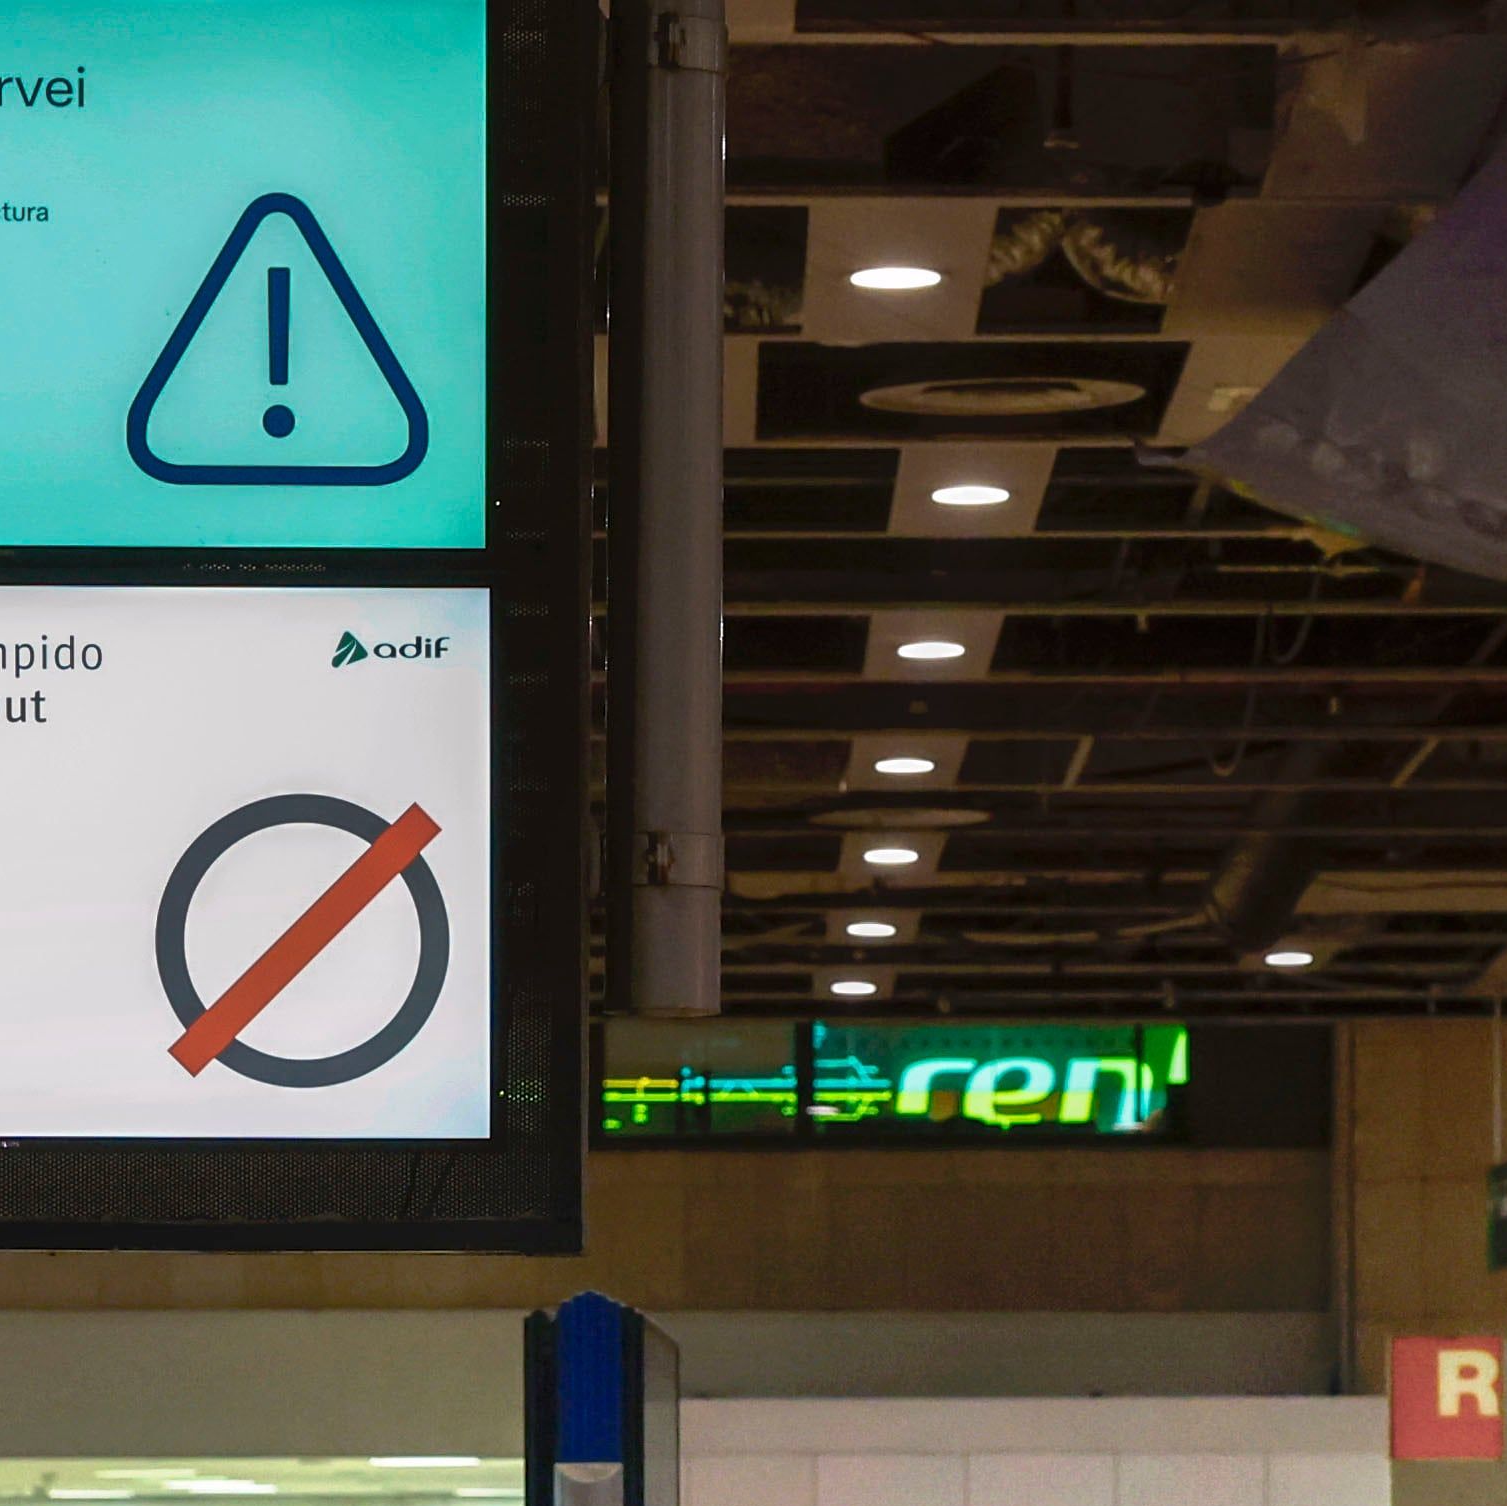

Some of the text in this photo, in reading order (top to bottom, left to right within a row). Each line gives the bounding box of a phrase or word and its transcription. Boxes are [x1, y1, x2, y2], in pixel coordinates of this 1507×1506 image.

[373, 635, 450, 659] adif
[895, 1030, 1188, 1130] ren
[1438, 1350, 1499, 1417] R
